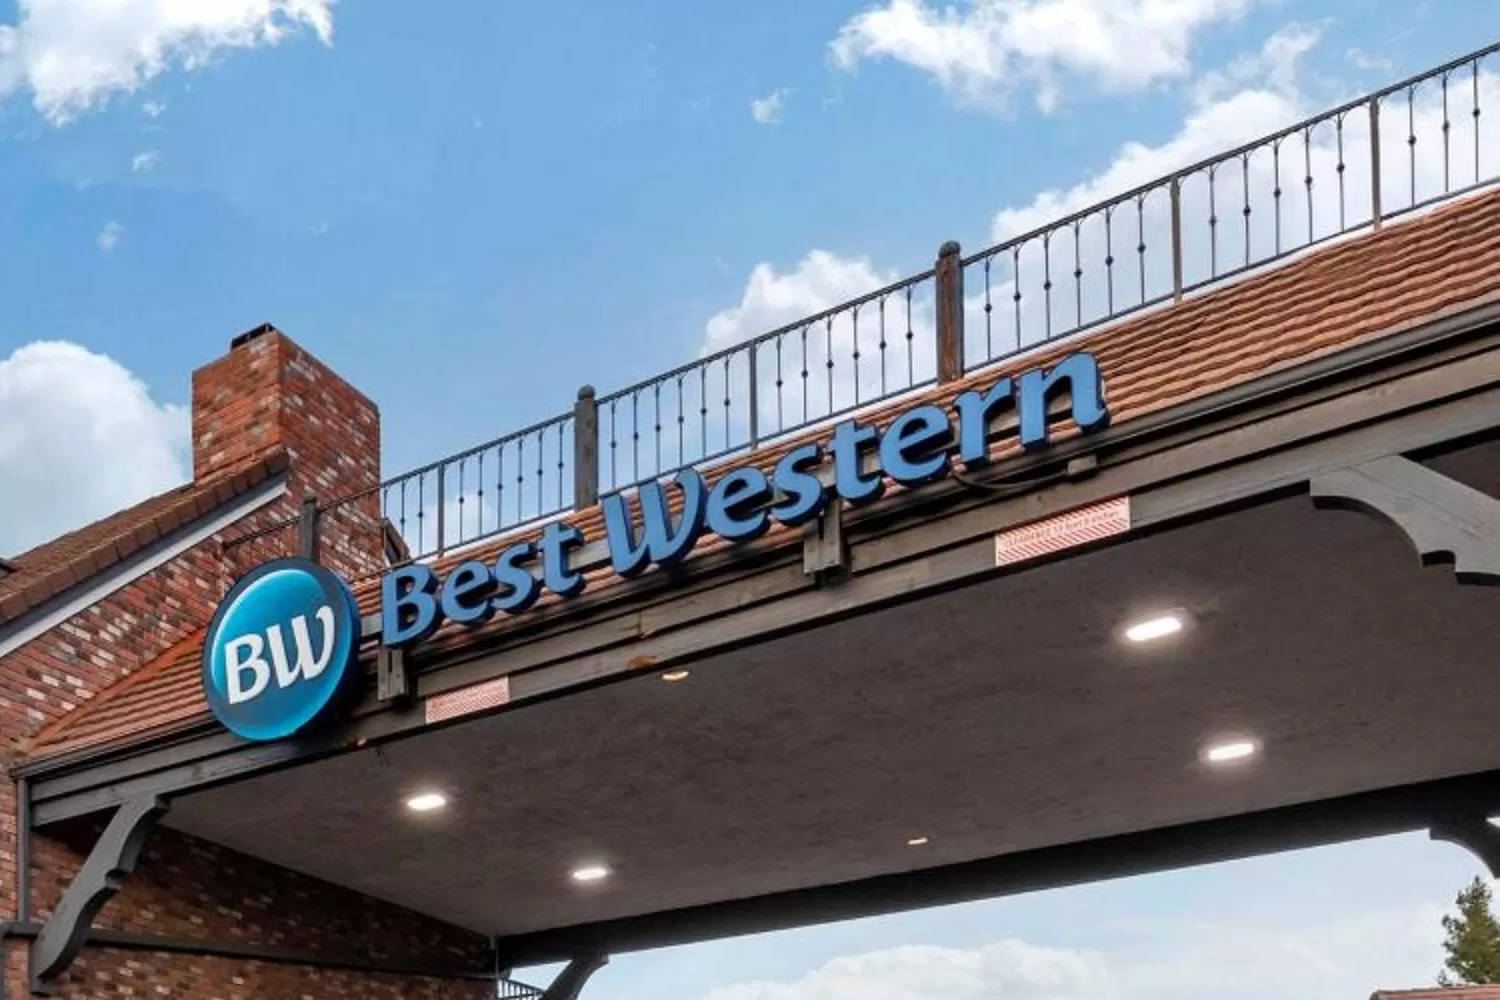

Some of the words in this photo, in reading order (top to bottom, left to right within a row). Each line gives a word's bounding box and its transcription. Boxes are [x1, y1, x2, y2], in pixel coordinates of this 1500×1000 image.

[381, 520, 585, 645] Best
[602, 352, 1108, 575] Western
[225, 605, 336, 704] BW
